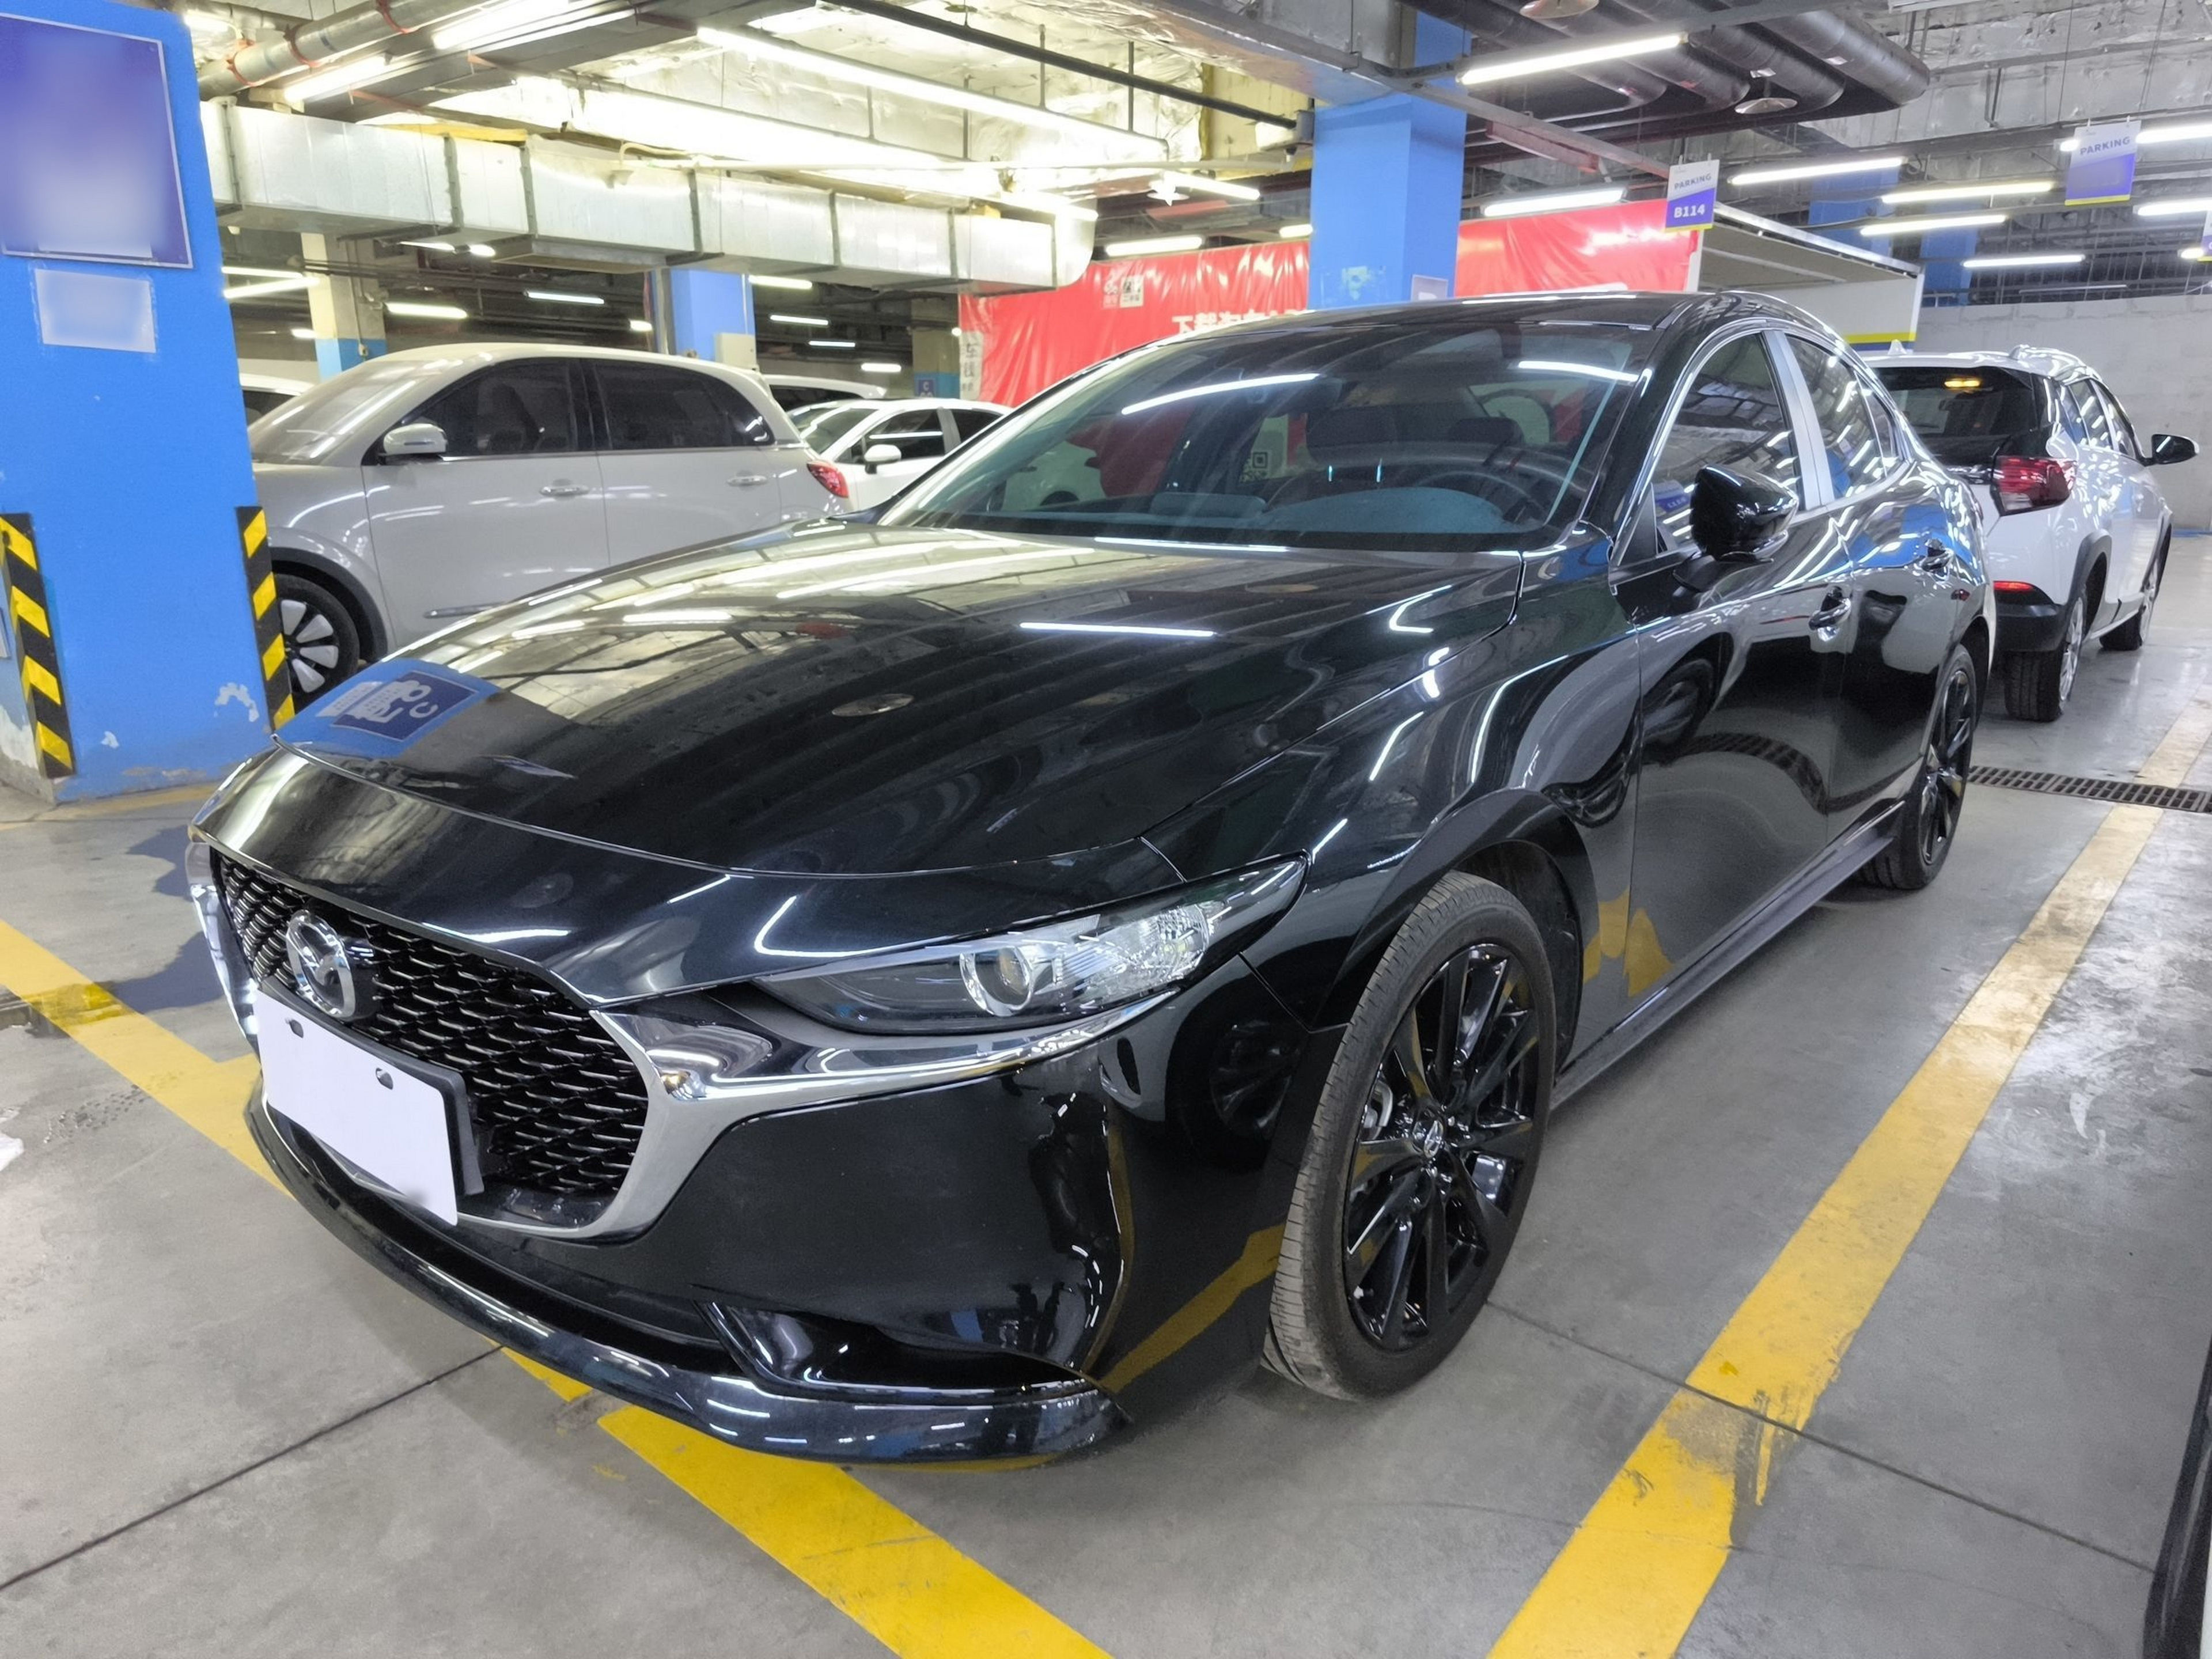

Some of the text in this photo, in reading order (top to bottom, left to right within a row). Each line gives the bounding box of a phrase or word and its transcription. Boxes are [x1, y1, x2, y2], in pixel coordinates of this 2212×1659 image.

[2080, 136, 2131, 155] PARKING
[1674, 173, 1712, 189] PARKING
[1673, 203, 1705, 218] B114
[923, 381, 930, 392] C
